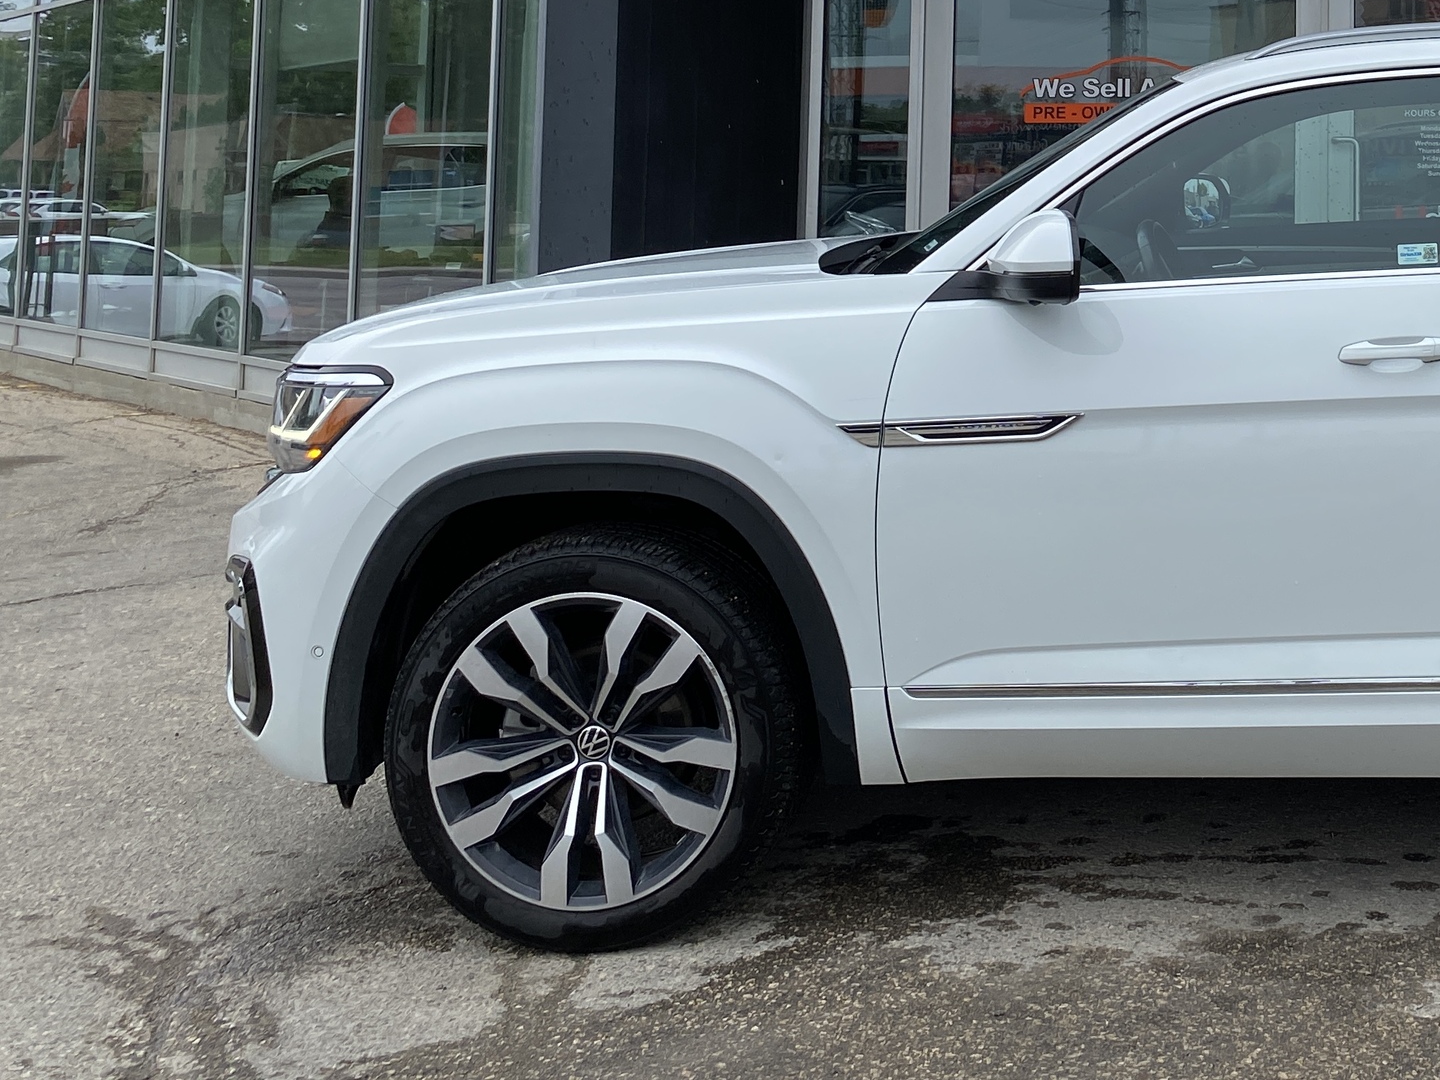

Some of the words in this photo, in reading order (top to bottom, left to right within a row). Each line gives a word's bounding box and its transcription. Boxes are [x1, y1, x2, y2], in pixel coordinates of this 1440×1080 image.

[1033, 78, 1076, 99] We
[1082, 77, 1131, 99] Sell
[1033, 106, 1066, 120] PRE
